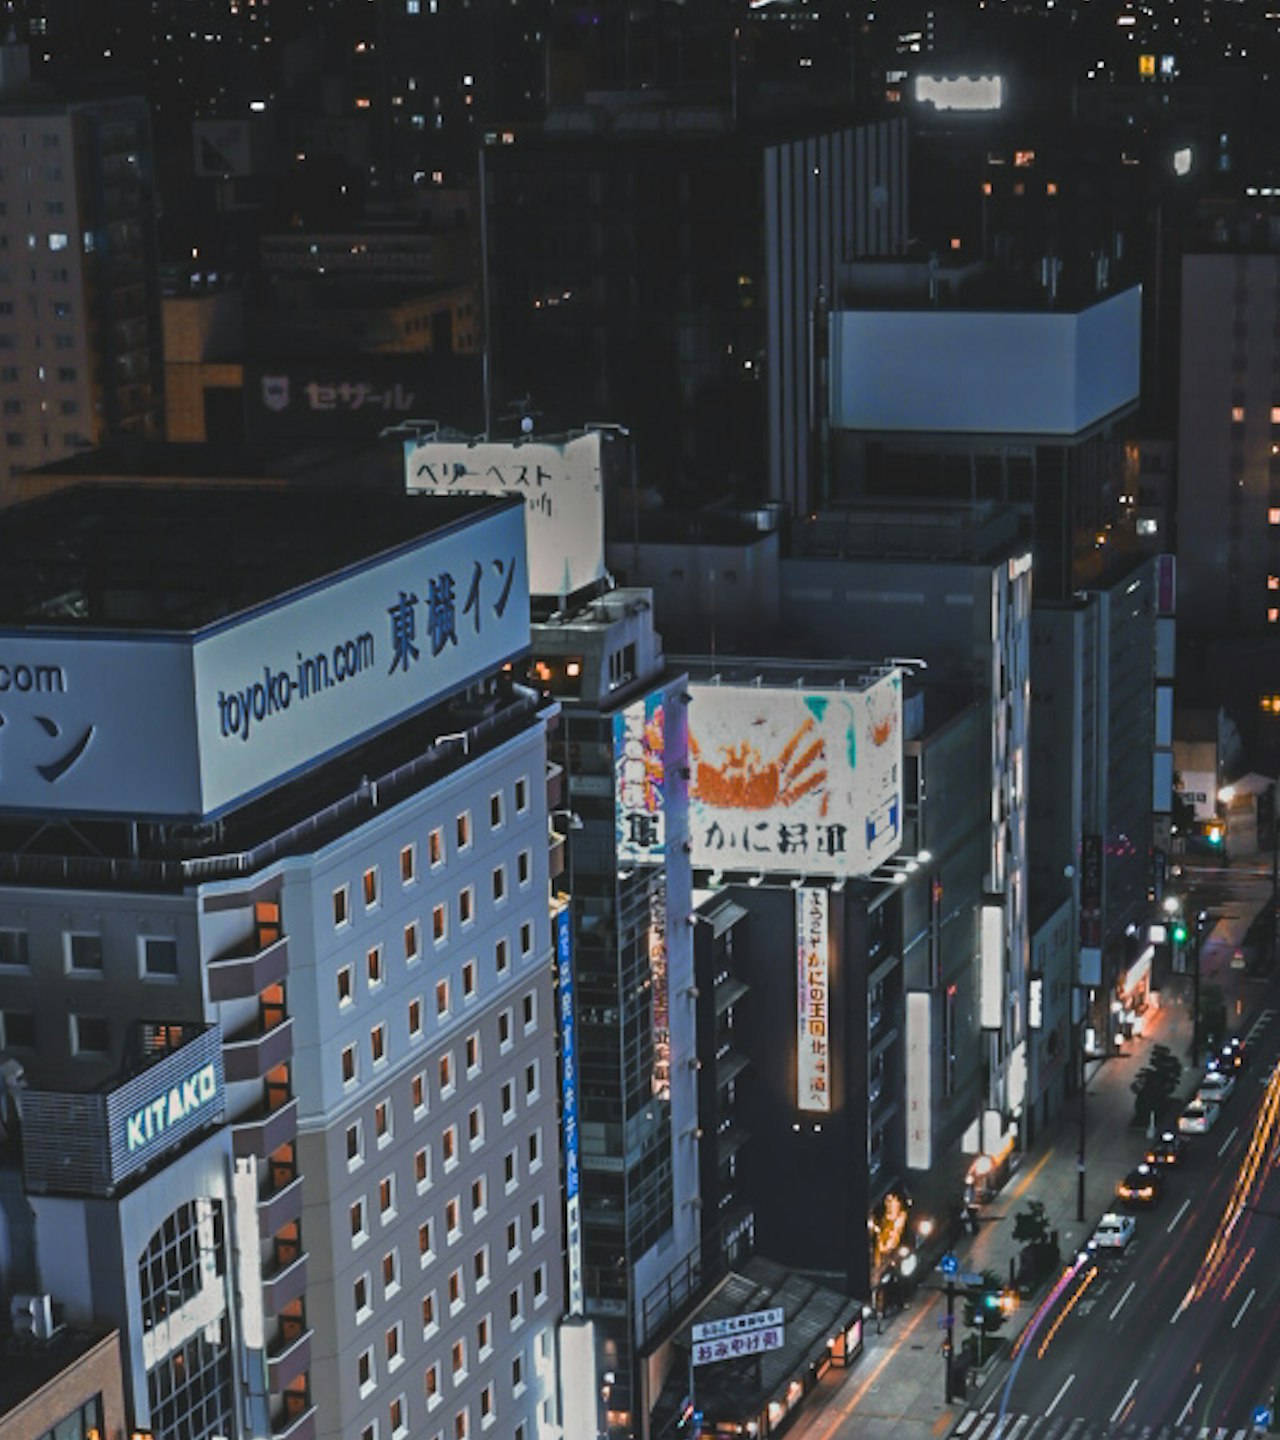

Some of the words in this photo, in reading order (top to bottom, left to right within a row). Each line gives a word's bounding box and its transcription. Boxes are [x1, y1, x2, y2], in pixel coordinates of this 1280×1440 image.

[218, 629, 376, 741] toyoko-inn.com
[387, 555, 517, 676] 東横イン
[126, 1063, 217, 1151] KITAKO
